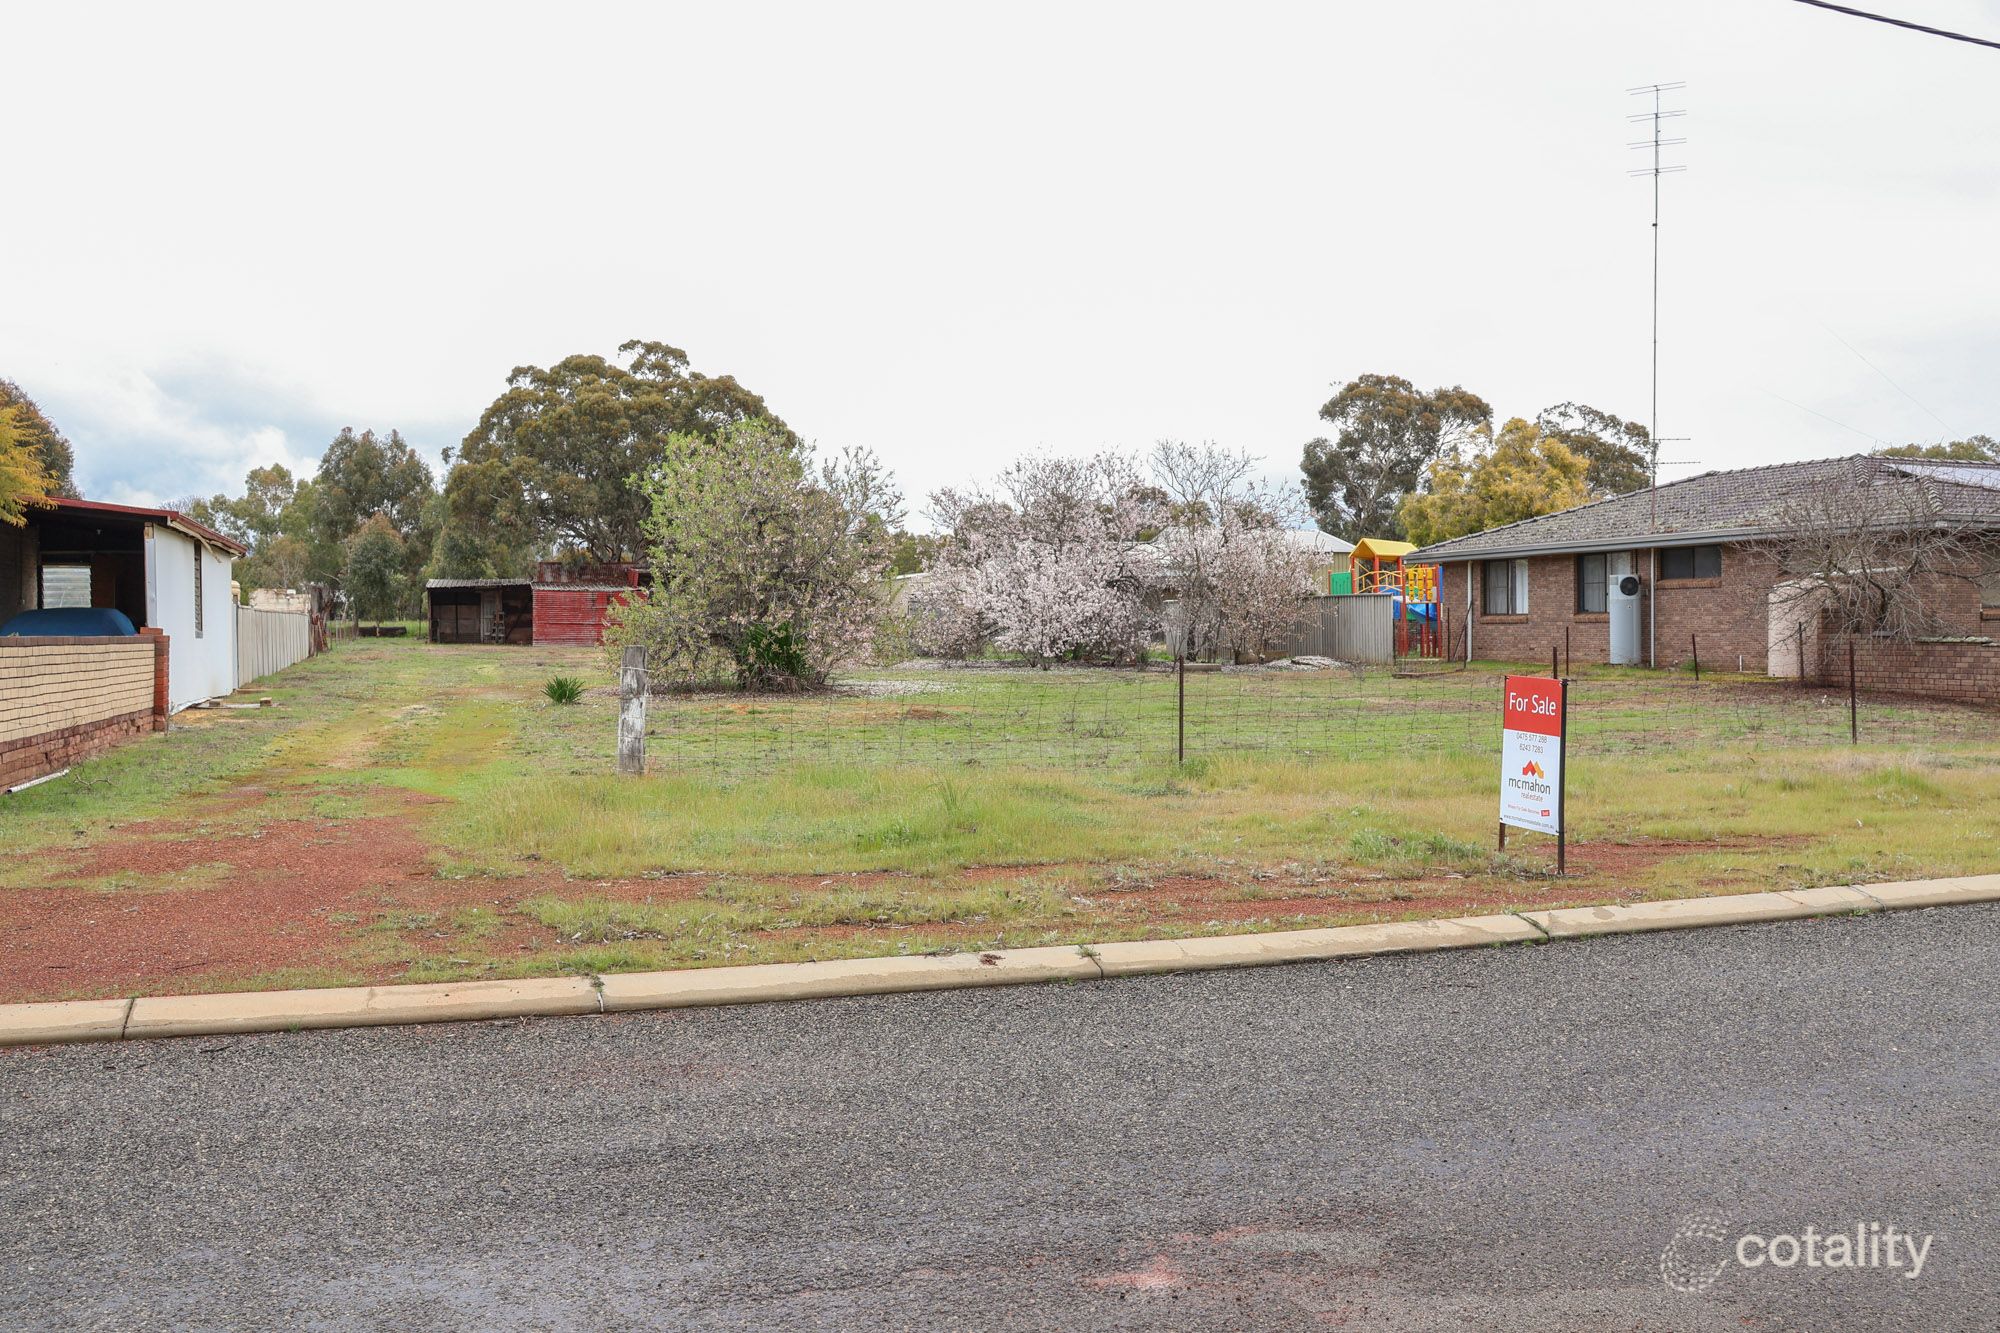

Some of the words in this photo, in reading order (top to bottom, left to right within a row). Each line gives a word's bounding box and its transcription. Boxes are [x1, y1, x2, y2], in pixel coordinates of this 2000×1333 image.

[1509, 692, 1528, 712] For
[1531, 694, 1556, 716] Sale
[1508, 778, 1551, 795] mcmahon
